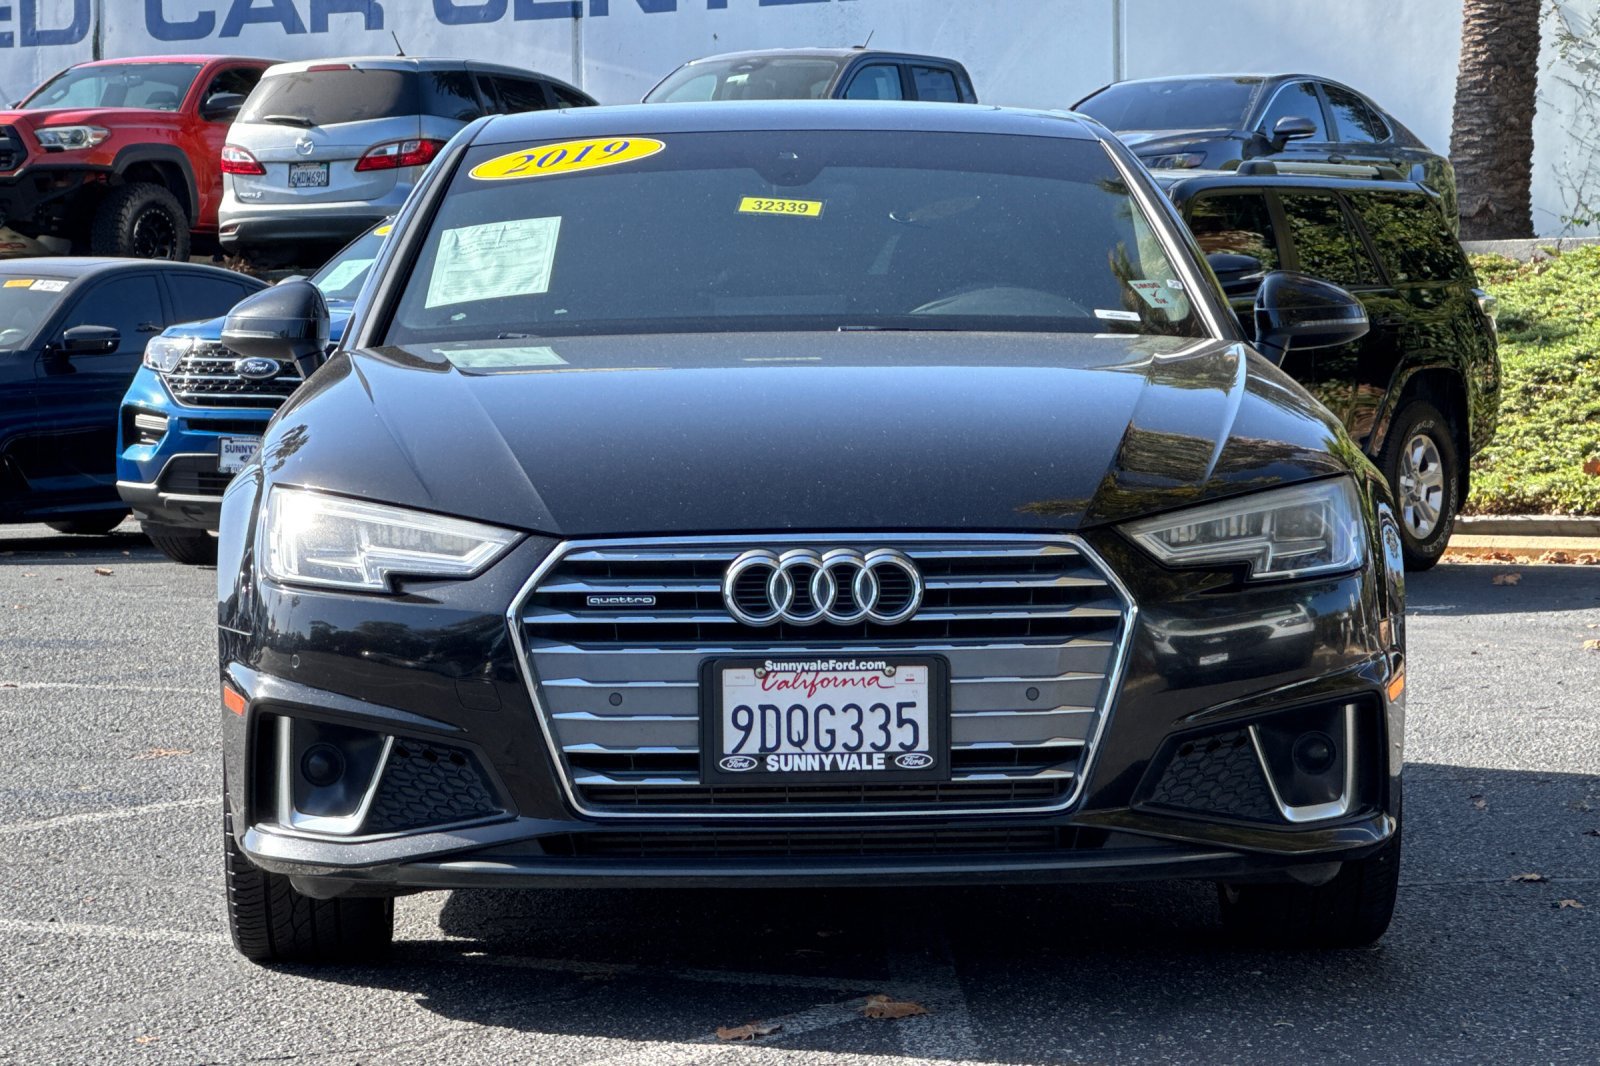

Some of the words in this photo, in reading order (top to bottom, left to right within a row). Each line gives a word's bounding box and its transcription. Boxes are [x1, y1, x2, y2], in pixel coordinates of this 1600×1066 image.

[503, 141, 630, 175] 2019
[752, 200, 808, 213] 32339
[590, 597, 652, 605] quattro
[765, 660, 886, 673] SunnyvaleFord.com
[762, 671, 895, 698] California
[732, 701, 919, 753] 9DQG335
[727, 756, 750, 769] Ford
[766, 753, 886, 772] SUNNYVALE
[903, 754, 925, 766] Ford
